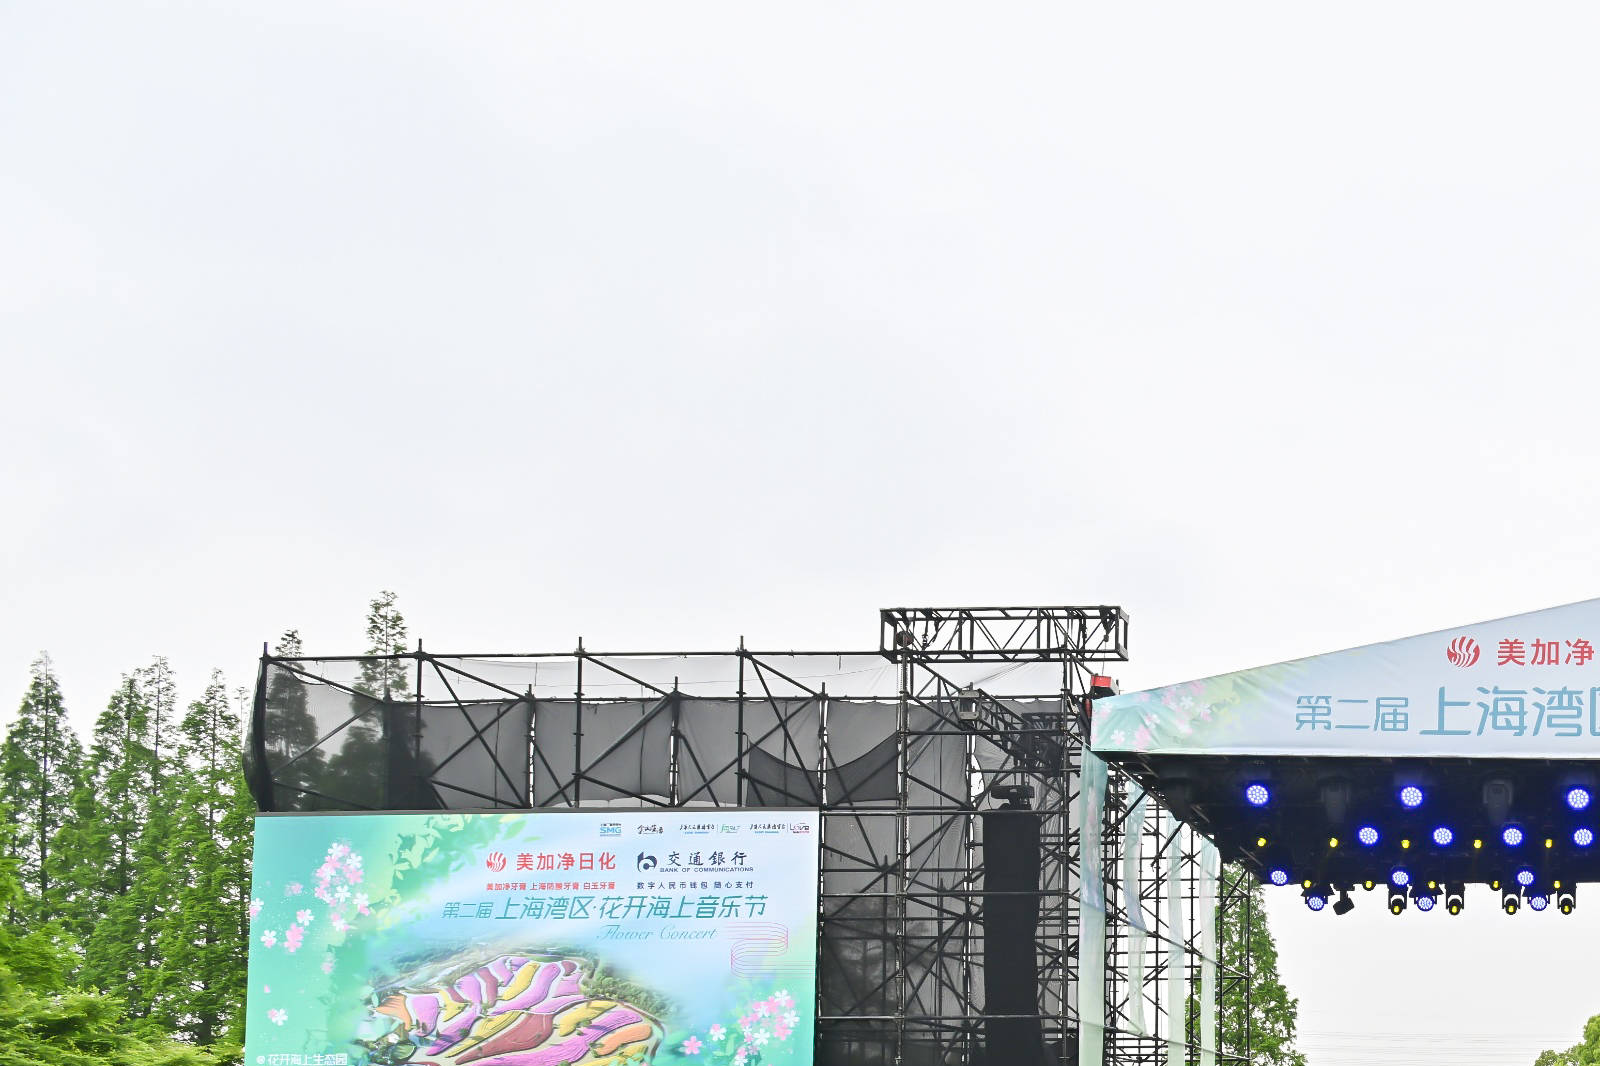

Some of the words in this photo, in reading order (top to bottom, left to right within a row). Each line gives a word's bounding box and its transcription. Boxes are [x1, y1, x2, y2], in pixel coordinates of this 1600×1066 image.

[517, 852, 616, 871] 美加净日化
[667, 851, 748, 867] 交通銀行
[597, 924, 654, 940] Flower
[661, 924, 718, 939] Concert
